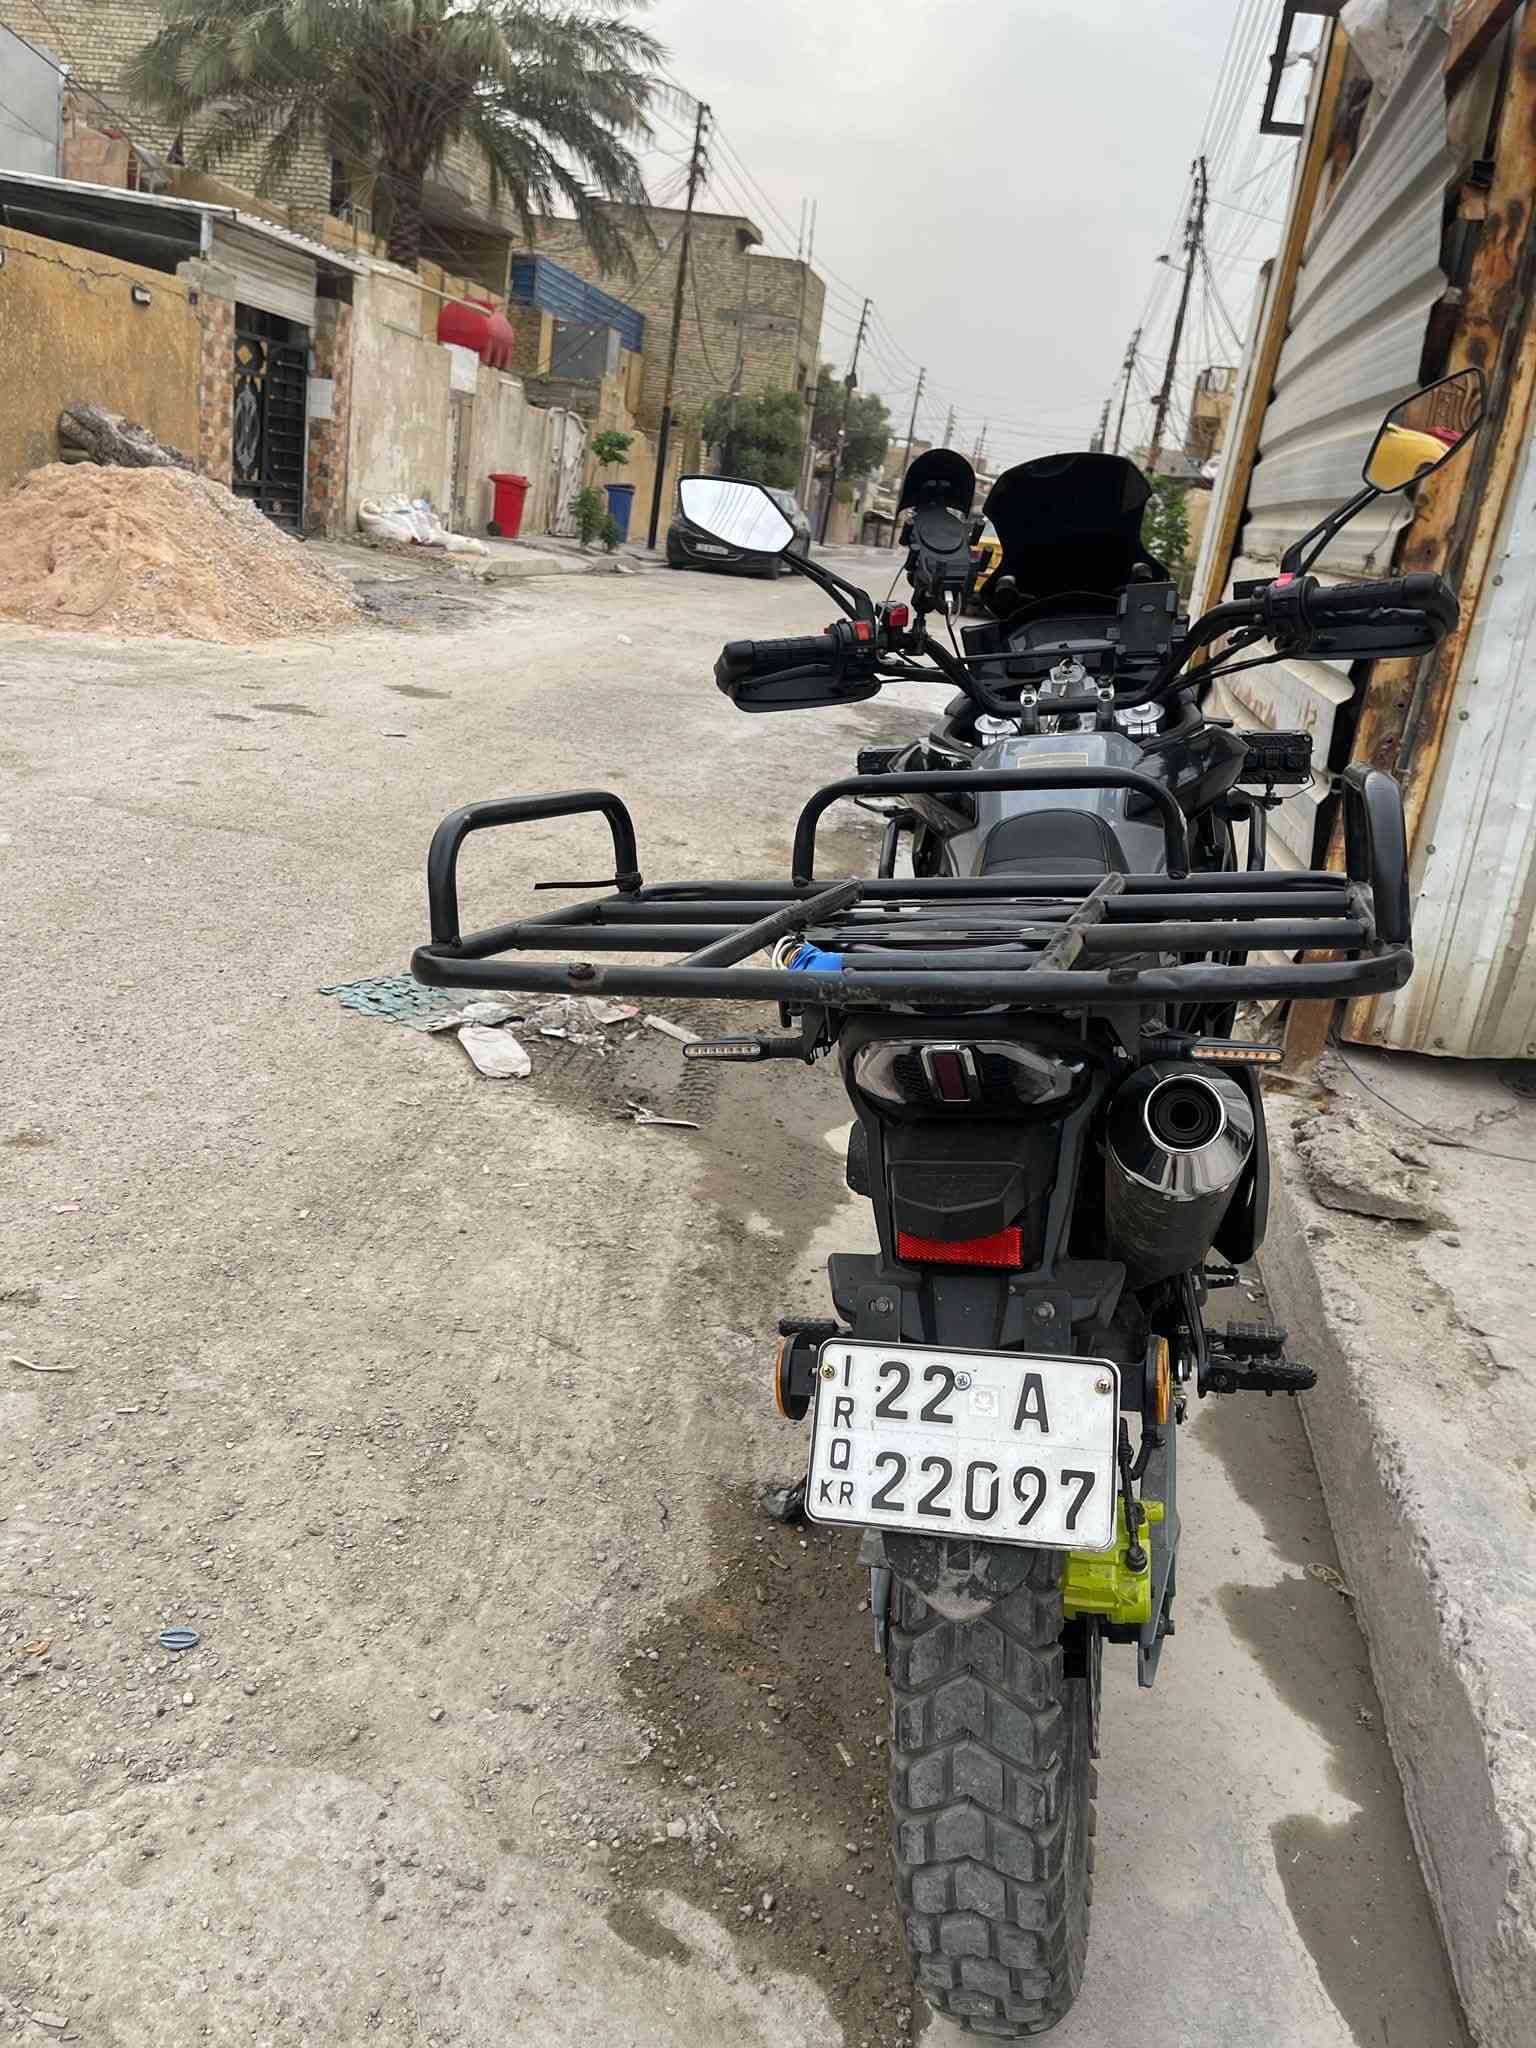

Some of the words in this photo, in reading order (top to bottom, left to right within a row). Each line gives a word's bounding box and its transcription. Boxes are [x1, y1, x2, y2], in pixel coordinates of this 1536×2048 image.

[875, 1361, 956, 1424] 22
[1013, 1372, 1050, 1434] A
[819, 1479, 855, 1506] KR
[871, 1451, 1096, 1531] 22097
